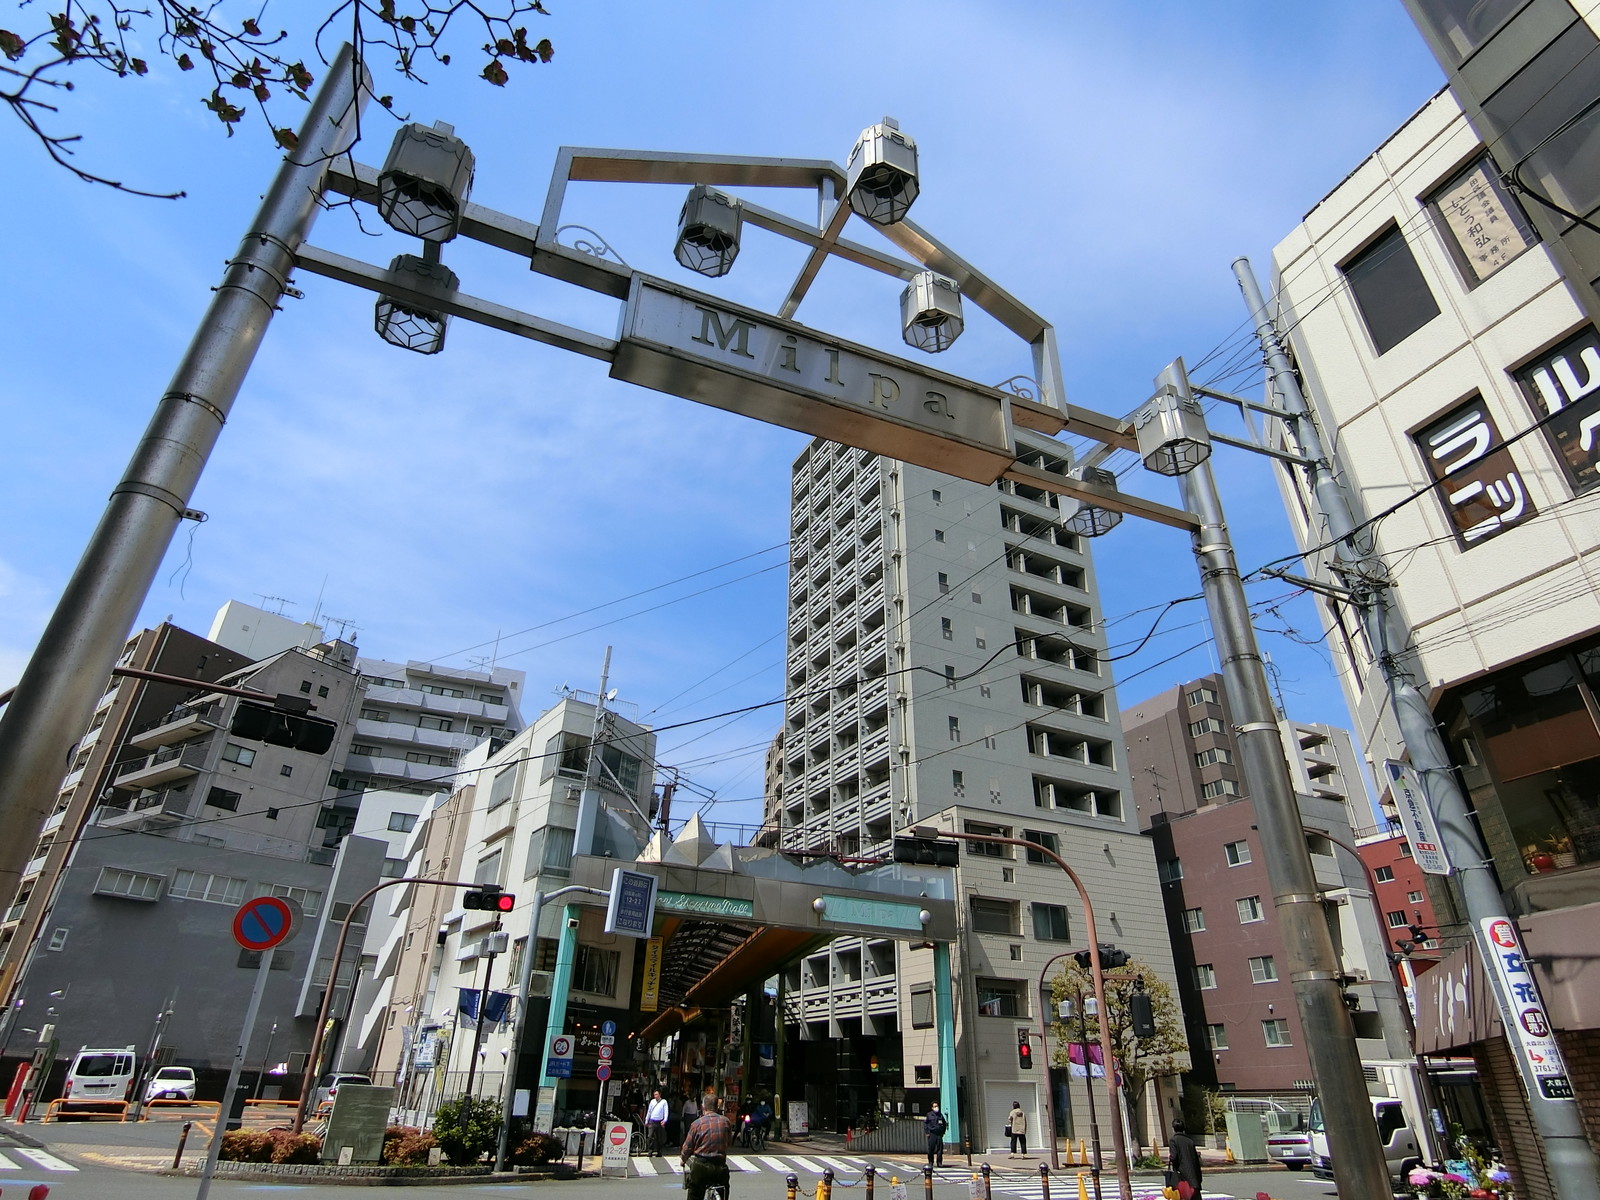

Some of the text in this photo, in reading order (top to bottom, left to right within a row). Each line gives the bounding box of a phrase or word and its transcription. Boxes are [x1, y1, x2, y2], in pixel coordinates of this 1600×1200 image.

[1468, 176, 1499, 224] 田区議会議員
[1452, 196, 1490, 248] いとう和弘
[1478, 236, 1511, 262] 事務所
[691, 306, 955, 420] Milpa
[721, 899, 748, 914] Mall
[1494, 924, 1516, 944] 質
[1503, 952, 1537, 1003] 立花
[606, 1146, 628, 1155] 12-22
